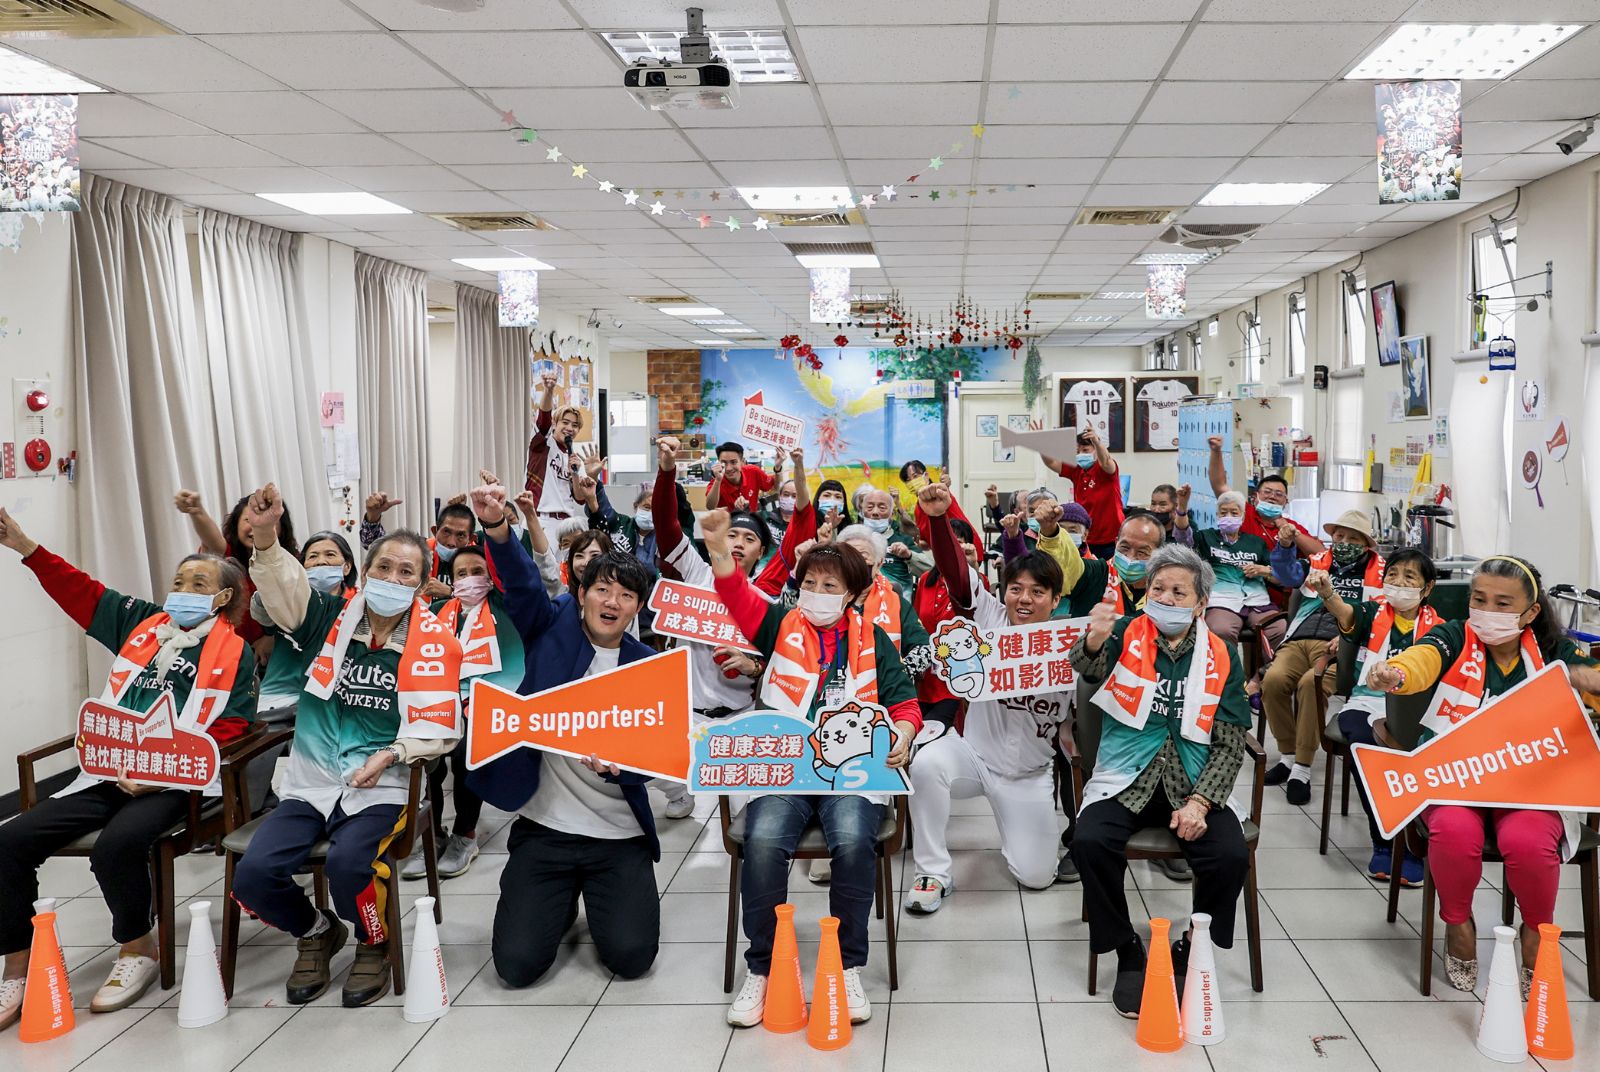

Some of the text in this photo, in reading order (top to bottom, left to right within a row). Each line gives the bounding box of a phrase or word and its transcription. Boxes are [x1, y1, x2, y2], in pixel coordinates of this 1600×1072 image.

[749, 407, 800, 434] Be supporters!
[1085, 398, 1101, 416] 10
[1152, 400, 1178, 410] Rakuten
[661, 586, 680, 605] Be
[998, 624, 1092, 660] 健康支
[411, 643, 445, 677] Be
[83, 709, 134, 744] 無論幾歲
[411, 710, 452, 719] Be supporters!
[490, 701, 665, 737] Be supporters!
[84, 743, 209, 781] 熱忱應援健康新生活
[708, 734, 804, 758] 健康支援
[1384, 727, 1569, 798] Be supporters!
[699, 763, 795, 786] 如影隨形
[841, 760, 869, 789] S
[44, 965, 64, 1029] Be supporters!
[826, 974, 840, 1040] Be supporters!
[1200, 970, 1213, 1036] Be supporters!
[1533, 981, 1550, 1048] Be supporters!
